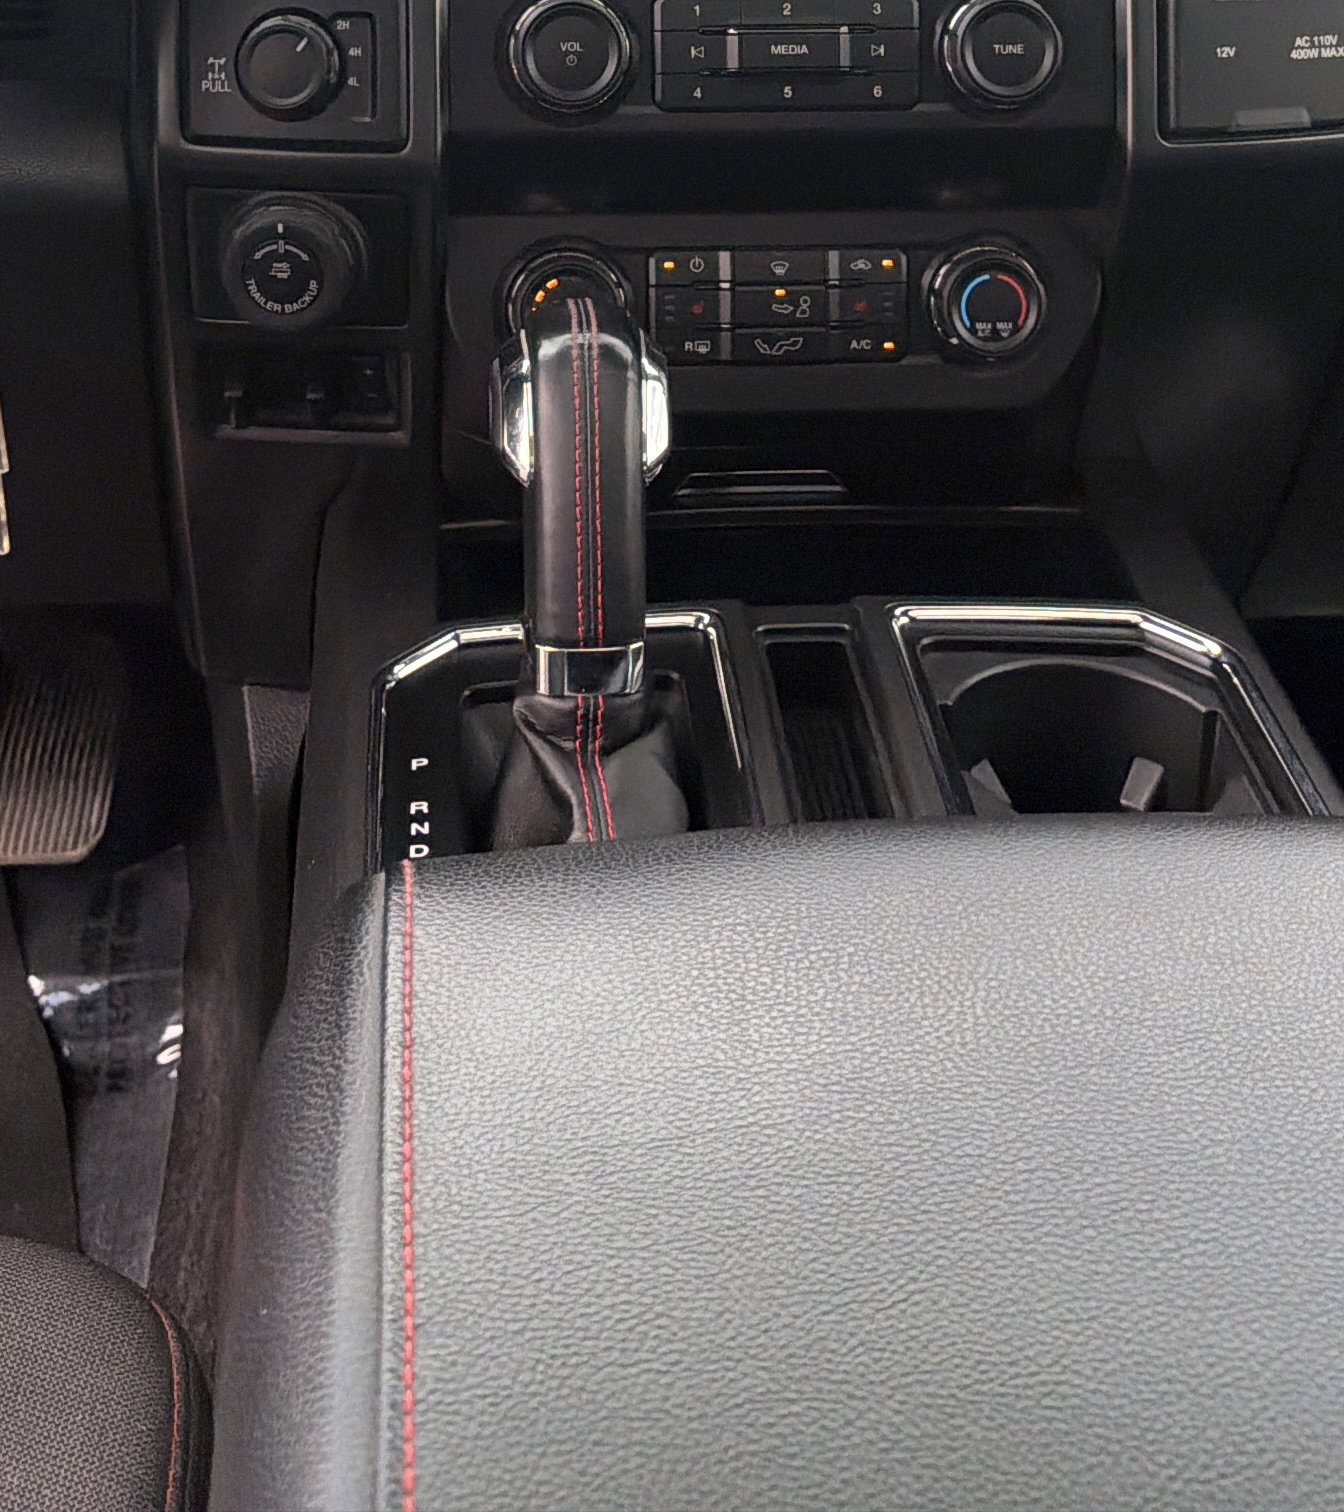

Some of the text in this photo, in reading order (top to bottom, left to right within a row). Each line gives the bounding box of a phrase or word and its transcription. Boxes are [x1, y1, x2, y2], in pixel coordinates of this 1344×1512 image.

[693, 5, 701, 16] 1
[782, 4, 792, 16] 2
[872, 3, 882, 15] 3
[336, 20, 350, 30] 2H
[559, 41, 584, 53] VOL
[1294, 34, 1338, 48] AC 110V
[348, 47, 362, 57] 4H
[770, 43, 809, 56] MEDIA
[993, 44, 1025, 55] TUNE
[1216, 46, 1236, 58] 12V
[1289, 48, 1319, 59] 400W
[201, 80, 232, 93] PULL
[347, 76, 359, 86] 4L
[693, 87, 702, 99] 4
[783, 86, 793, 99] 5
[873, 86, 882, 98] 6
[245, 278, 319, 314] TRAILER BACKUP
[685, 341, 694, 352] R
[850, 339, 872, 350] A/C
[411, 757, 429, 771] P
[409, 801, 429, 815] R
[410, 821, 429, 836] N
[409, 844, 430, 859] D
